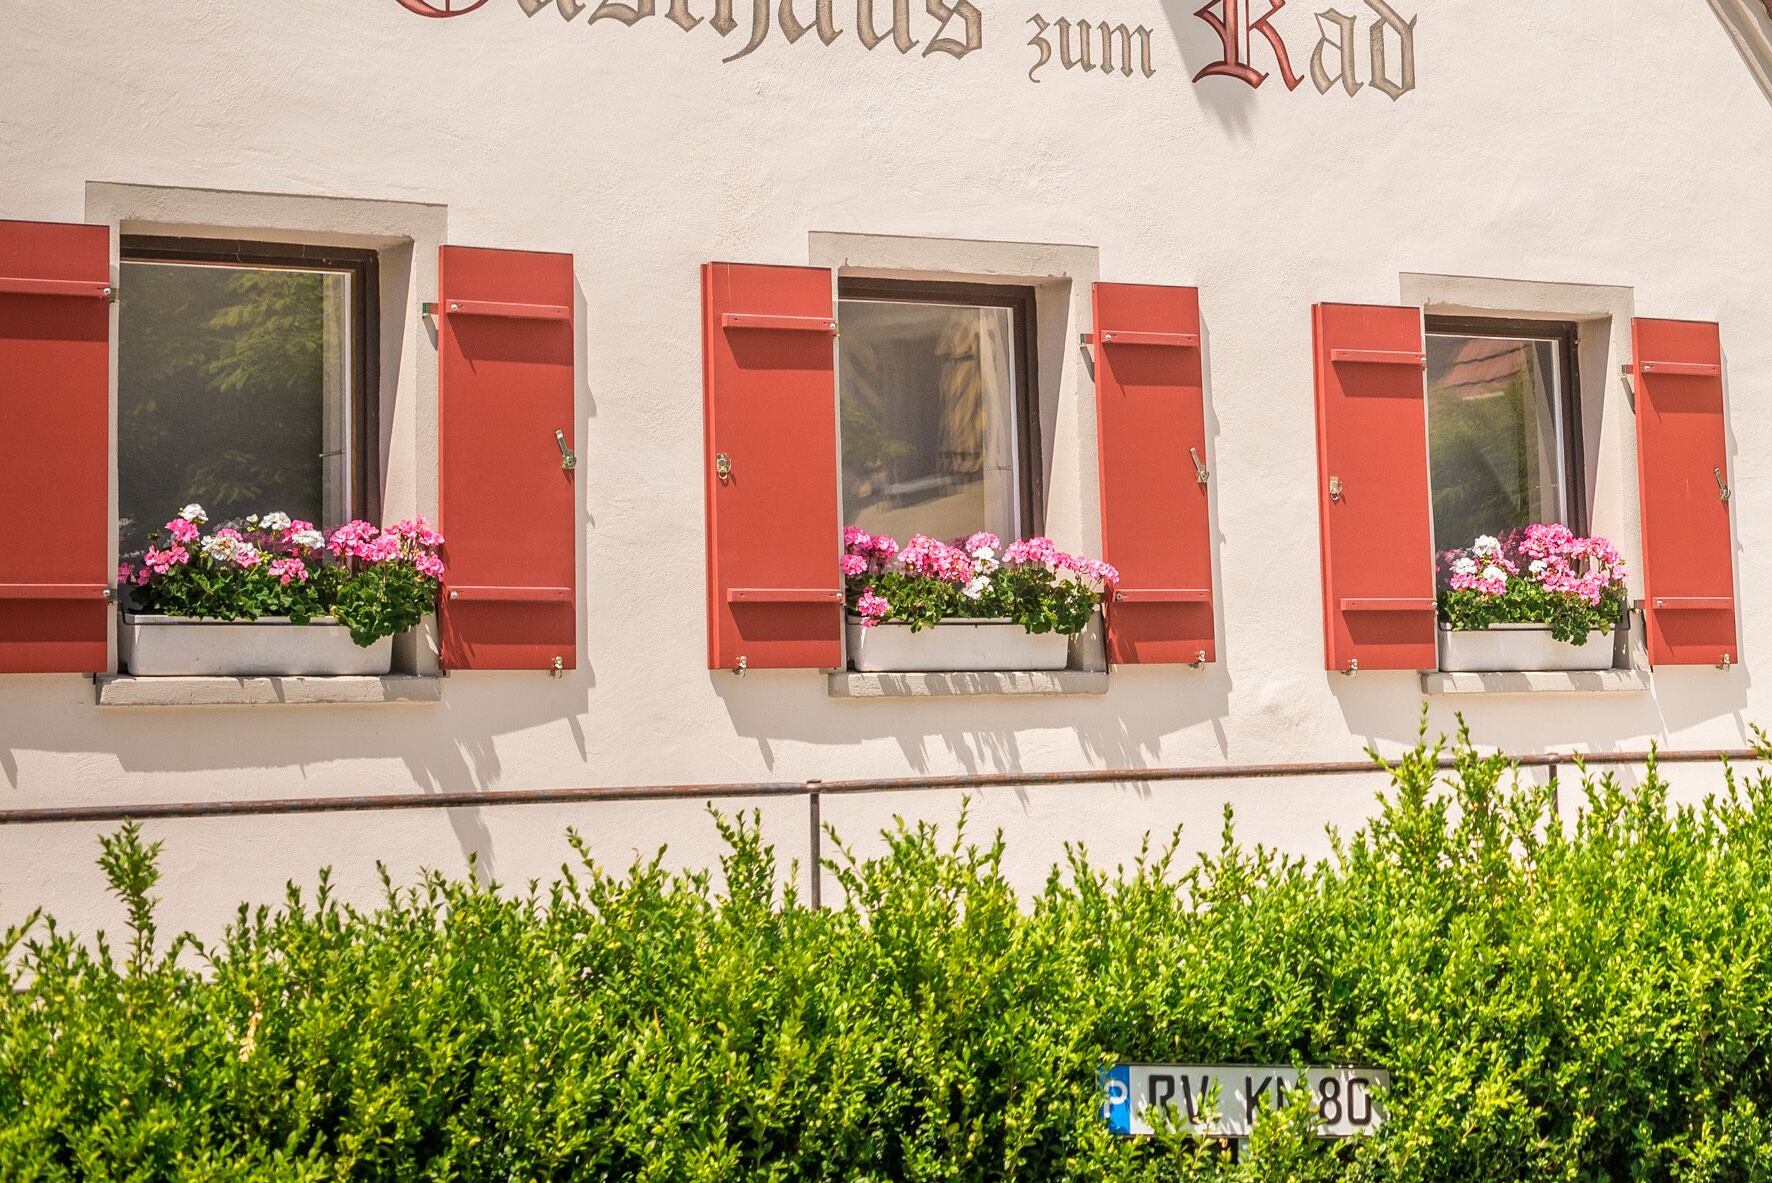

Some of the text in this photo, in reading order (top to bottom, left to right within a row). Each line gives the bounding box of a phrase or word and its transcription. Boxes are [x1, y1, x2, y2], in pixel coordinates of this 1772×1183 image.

[1026, 13, 1156, 83] zum
[1103, 1079, 1128, 1118] P
[1148, 1074, 1209, 1125] RV
[1319, 1076, 1372, 1126] 80
